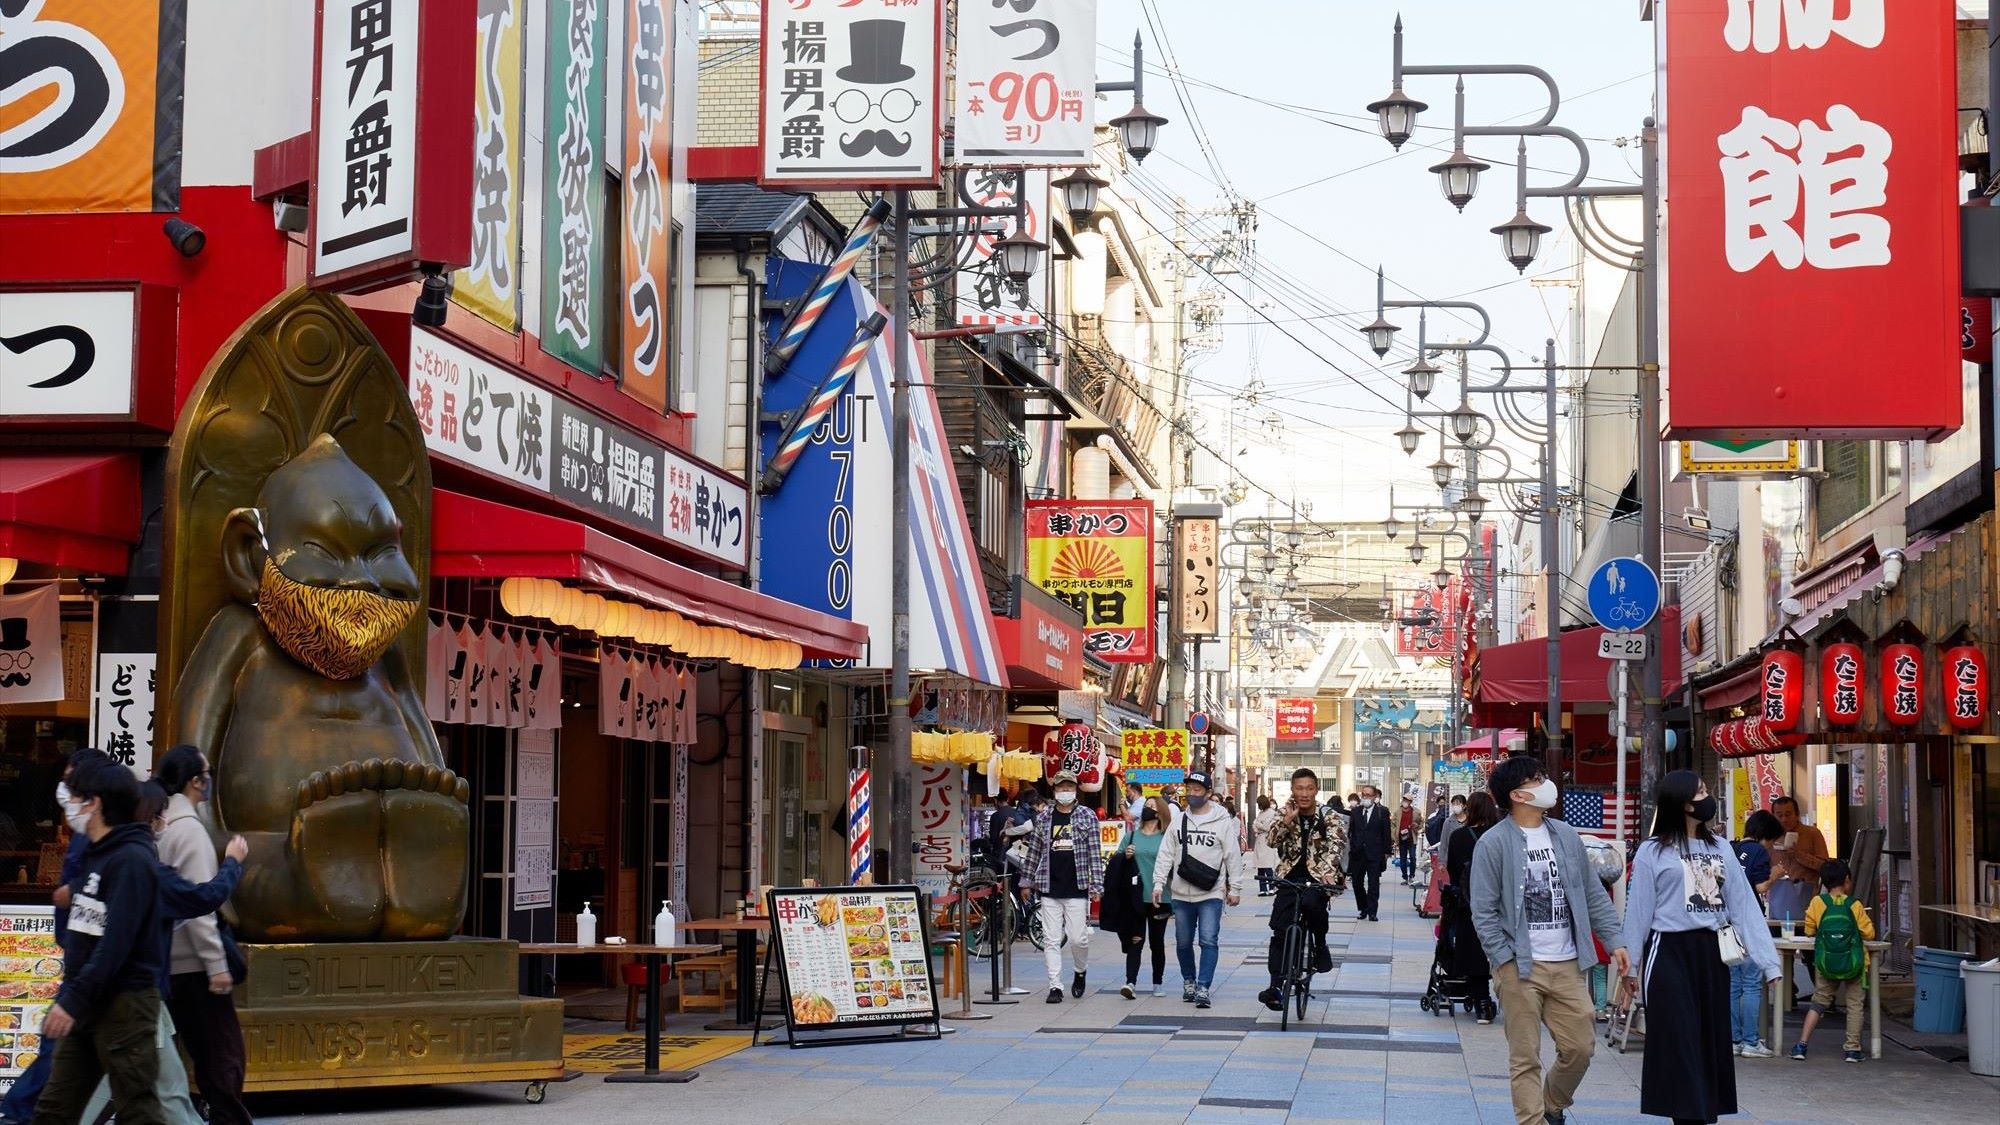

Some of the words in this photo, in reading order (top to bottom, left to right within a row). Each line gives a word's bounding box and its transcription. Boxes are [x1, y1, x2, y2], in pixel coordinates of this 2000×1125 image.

[779, 20, 827, 159] 揚男爵
[989, 72, 1059, 122] 90
[1061, 100, 1082, 122] 円
[1005, 124, 1041, 144] ヨリ
[632, 0, 665, 366] 串かつ
[415, 346, 459, 386] こだわりの
[414, 378, 458, 444] 逸品
[462, 367, 543, 481] どて焼
[562, 413, 589, 457] 新世界
[561, 454, 588, 492] 串かつ
[607, 437, 655, 521] 揚男爵
[669, 465, 691, 492] 新世界
[669, 491, 691, 535] 名物
[695, 475, 742, 549] 串かつ
[1049, 513, 1129, 535] 串かつ
[1084, 631, 1133, 651] モン
[1602, 640, 1642, 655] 9-22
[1765, 662, 1786, 722] たこ焼
[1834, 654, 1857, 715] たこ焼
[1893, 654, 1918, 716] たこ焼
[1954, 658, 1979, 719] たこ焼
[107, 664, 136, 766] どて焼
[1062, 730, 1084, 774] 射的
[1124, 731, 1185, 748] 日本最大
[1127, 748, 1183, 765] 射的場
[1528, 848, 1550, 862] WHAT
[779, 898, 820, 925] 串かつ
[1686, 904, 1726, 912] DISCOV
[282, 954, 486, 996] BILLIKEN
